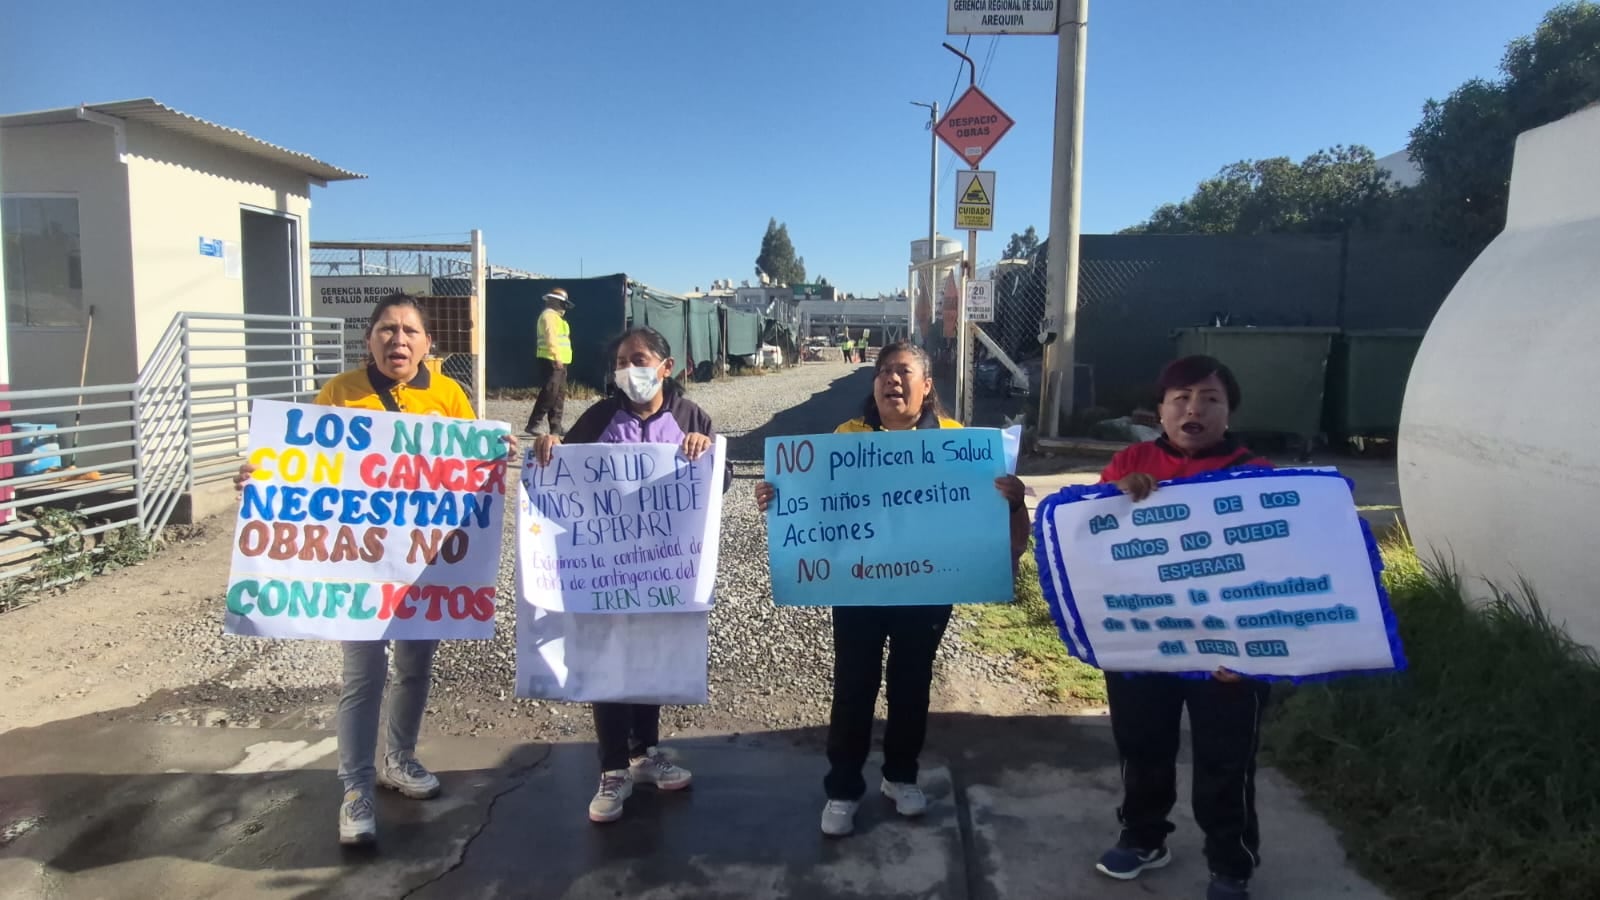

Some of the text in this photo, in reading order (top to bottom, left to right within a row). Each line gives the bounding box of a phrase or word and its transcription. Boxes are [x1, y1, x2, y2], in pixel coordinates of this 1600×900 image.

[953, 0, 1054, 11] GERENCIA REGIONAL DE SALUD
[981, 14, 1024, 26] AREQUIPA
[949, 114, 998, 128] DESPACIO
[956, 126, 990, 138] OBRAS
[958, 206, 991, 216] CUIDADO
[320, 287, 362, 296] GERENCIA
[322, 295, 333, 304] DE
[335, 295, 362, 304] SALUD
[973, 286, 984, 296] 20
[285, 409, 508, 460] LOS NIÑOS
[248, 447, 508, 494] CON CANCER
[584, 452, 655, 483] SALUD
[674, 455, 702, 481] DE
[776, 438, 995, 480] NO politicen la Salud
[240, 484, 493, 528] NECESITAN
[528, 482, 703, 519] NIÑOS NO PUEDE
[776, 481, 970, 517] Los niños necesitan
[1089, 490, 1300, 534] ¡LA SALUD DE LOS
[239, 520, 469, 565] OBRAS NO
[571, 512, 672, 547] ESPERAR!
[783, 521, 875, 548] Acciones
[1111, 519, 1290, 561] NIÑOS NO PUEDE
[591, 554, 605, 569] la
[614, 540, 682, 565] continuidad
[1158, 553, 1245, 582] ESPERAR!
[570, 577, 586, 590] de
[675, 560, 697, 580] del
[797, 557, 831, 584] NO
[226, 580, 496, 622] CONFLICTOS
[592, 584, 686, 611] IREN SUR
[1103, 574, 1332, 610] Exigimos la continuidad
[1103, 604, 1358, 633] de la obra de contingencia
[1158, 639, 1289, 658] del IREN SUR
